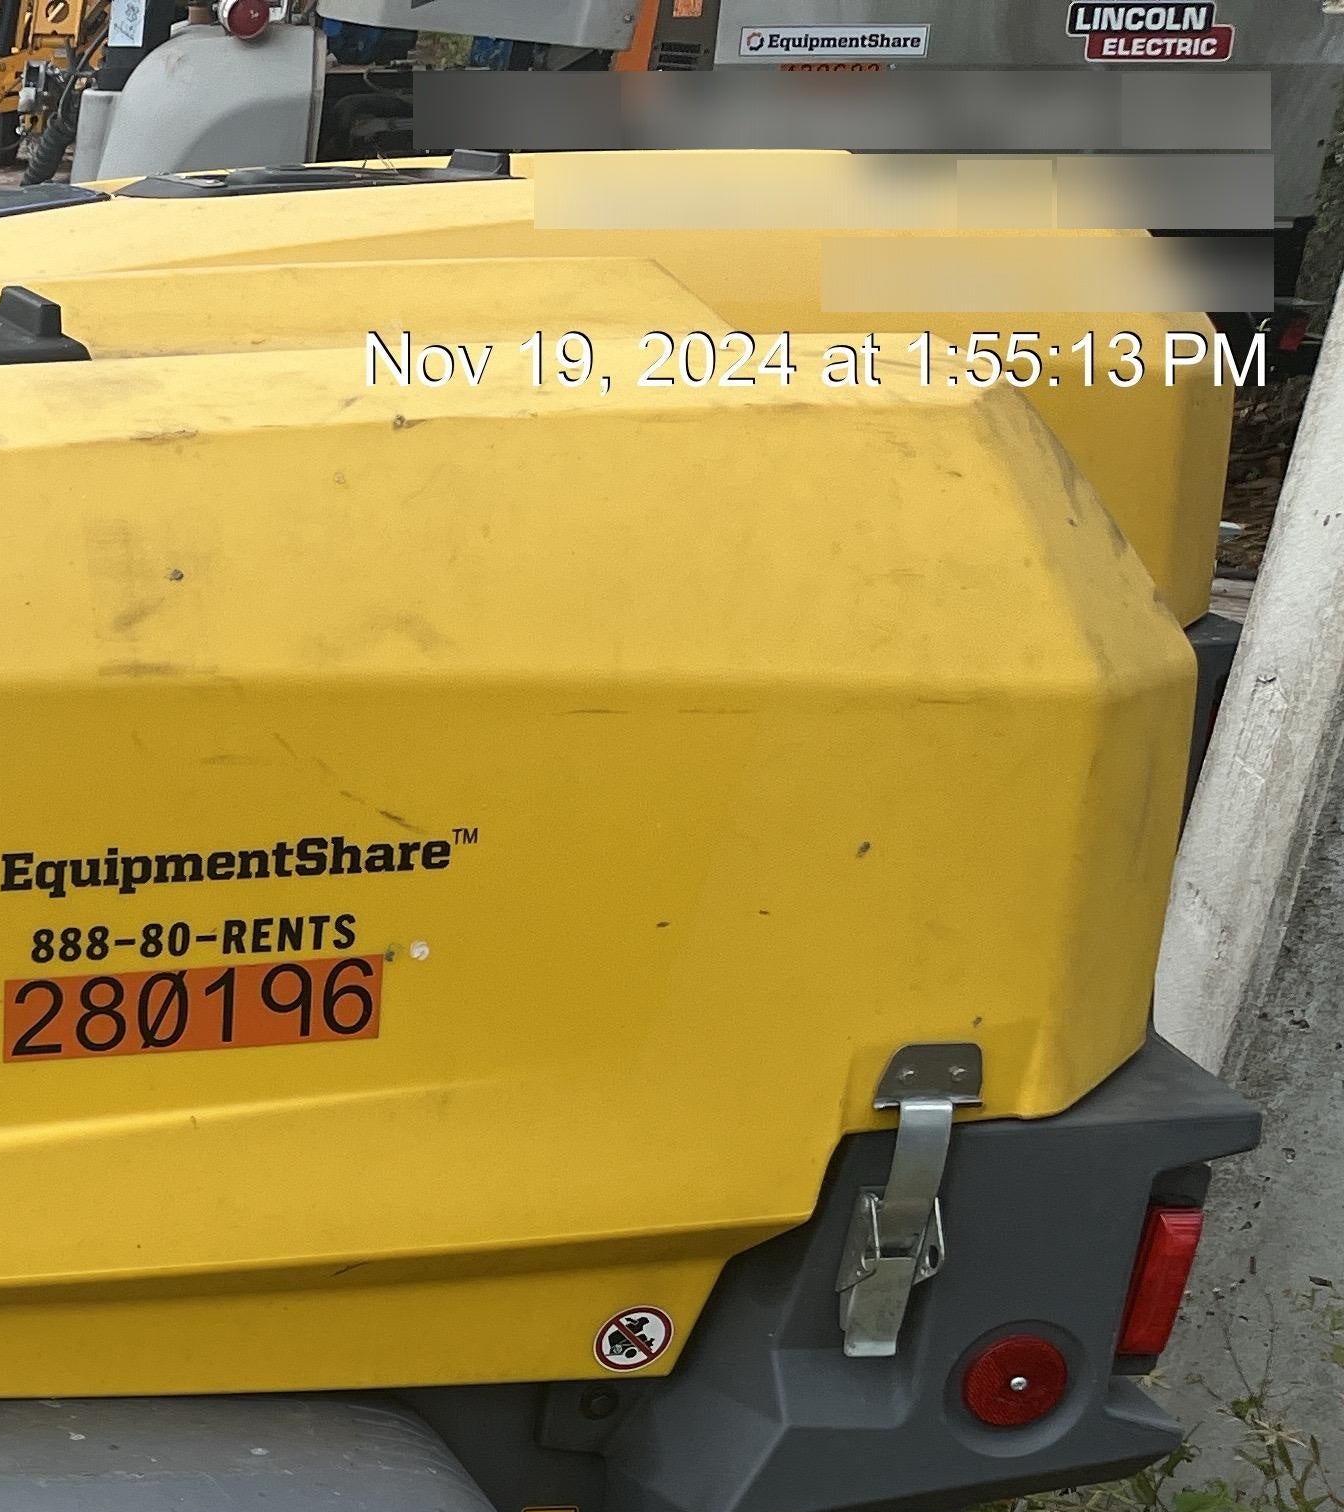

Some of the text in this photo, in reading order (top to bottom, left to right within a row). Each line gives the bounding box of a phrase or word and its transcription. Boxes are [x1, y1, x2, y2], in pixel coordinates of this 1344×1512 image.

[1075, 6, 1207, 31] LINCOLN
[766, 34, 921, 52] EquipmentShare
[1101, 37, 1218, 56] ELECTRIC
[0, 834, 452, 899] EquipmentShare
[30, 912, 357, 964] 888-80-RENTS
[10, 956, 375, 1058] 280196
